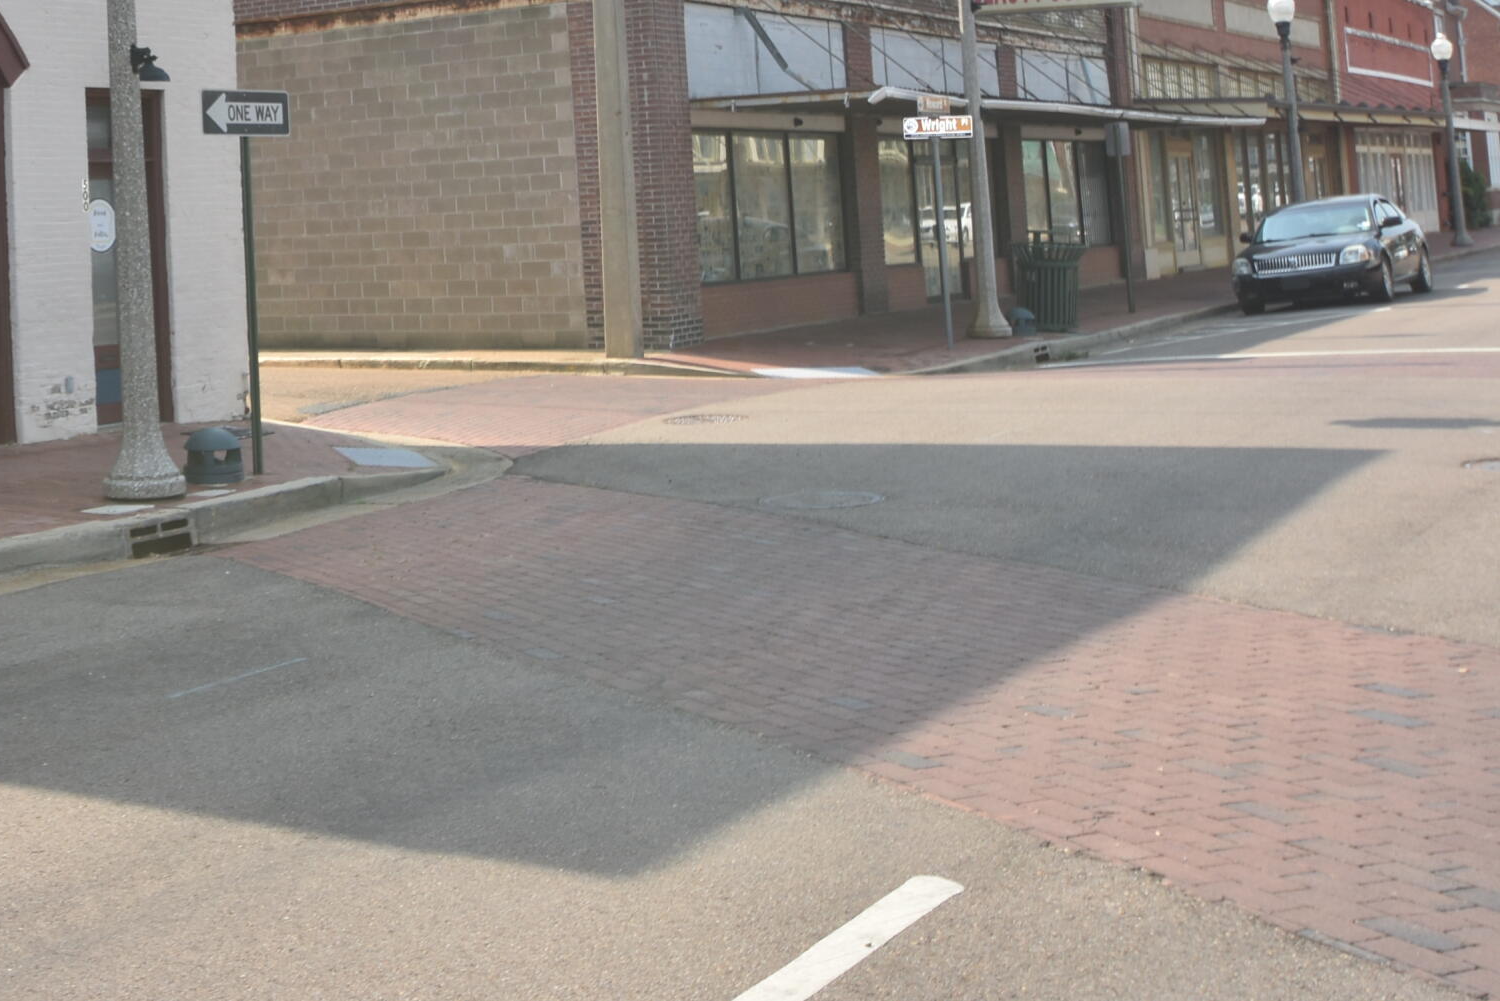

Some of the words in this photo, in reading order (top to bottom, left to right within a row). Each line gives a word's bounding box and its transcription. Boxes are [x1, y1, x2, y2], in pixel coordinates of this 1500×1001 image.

[228, 105, 251, 122] ONE
[255, 105, 279, 122] WAY
[921, 118, 957, 133] Wright
